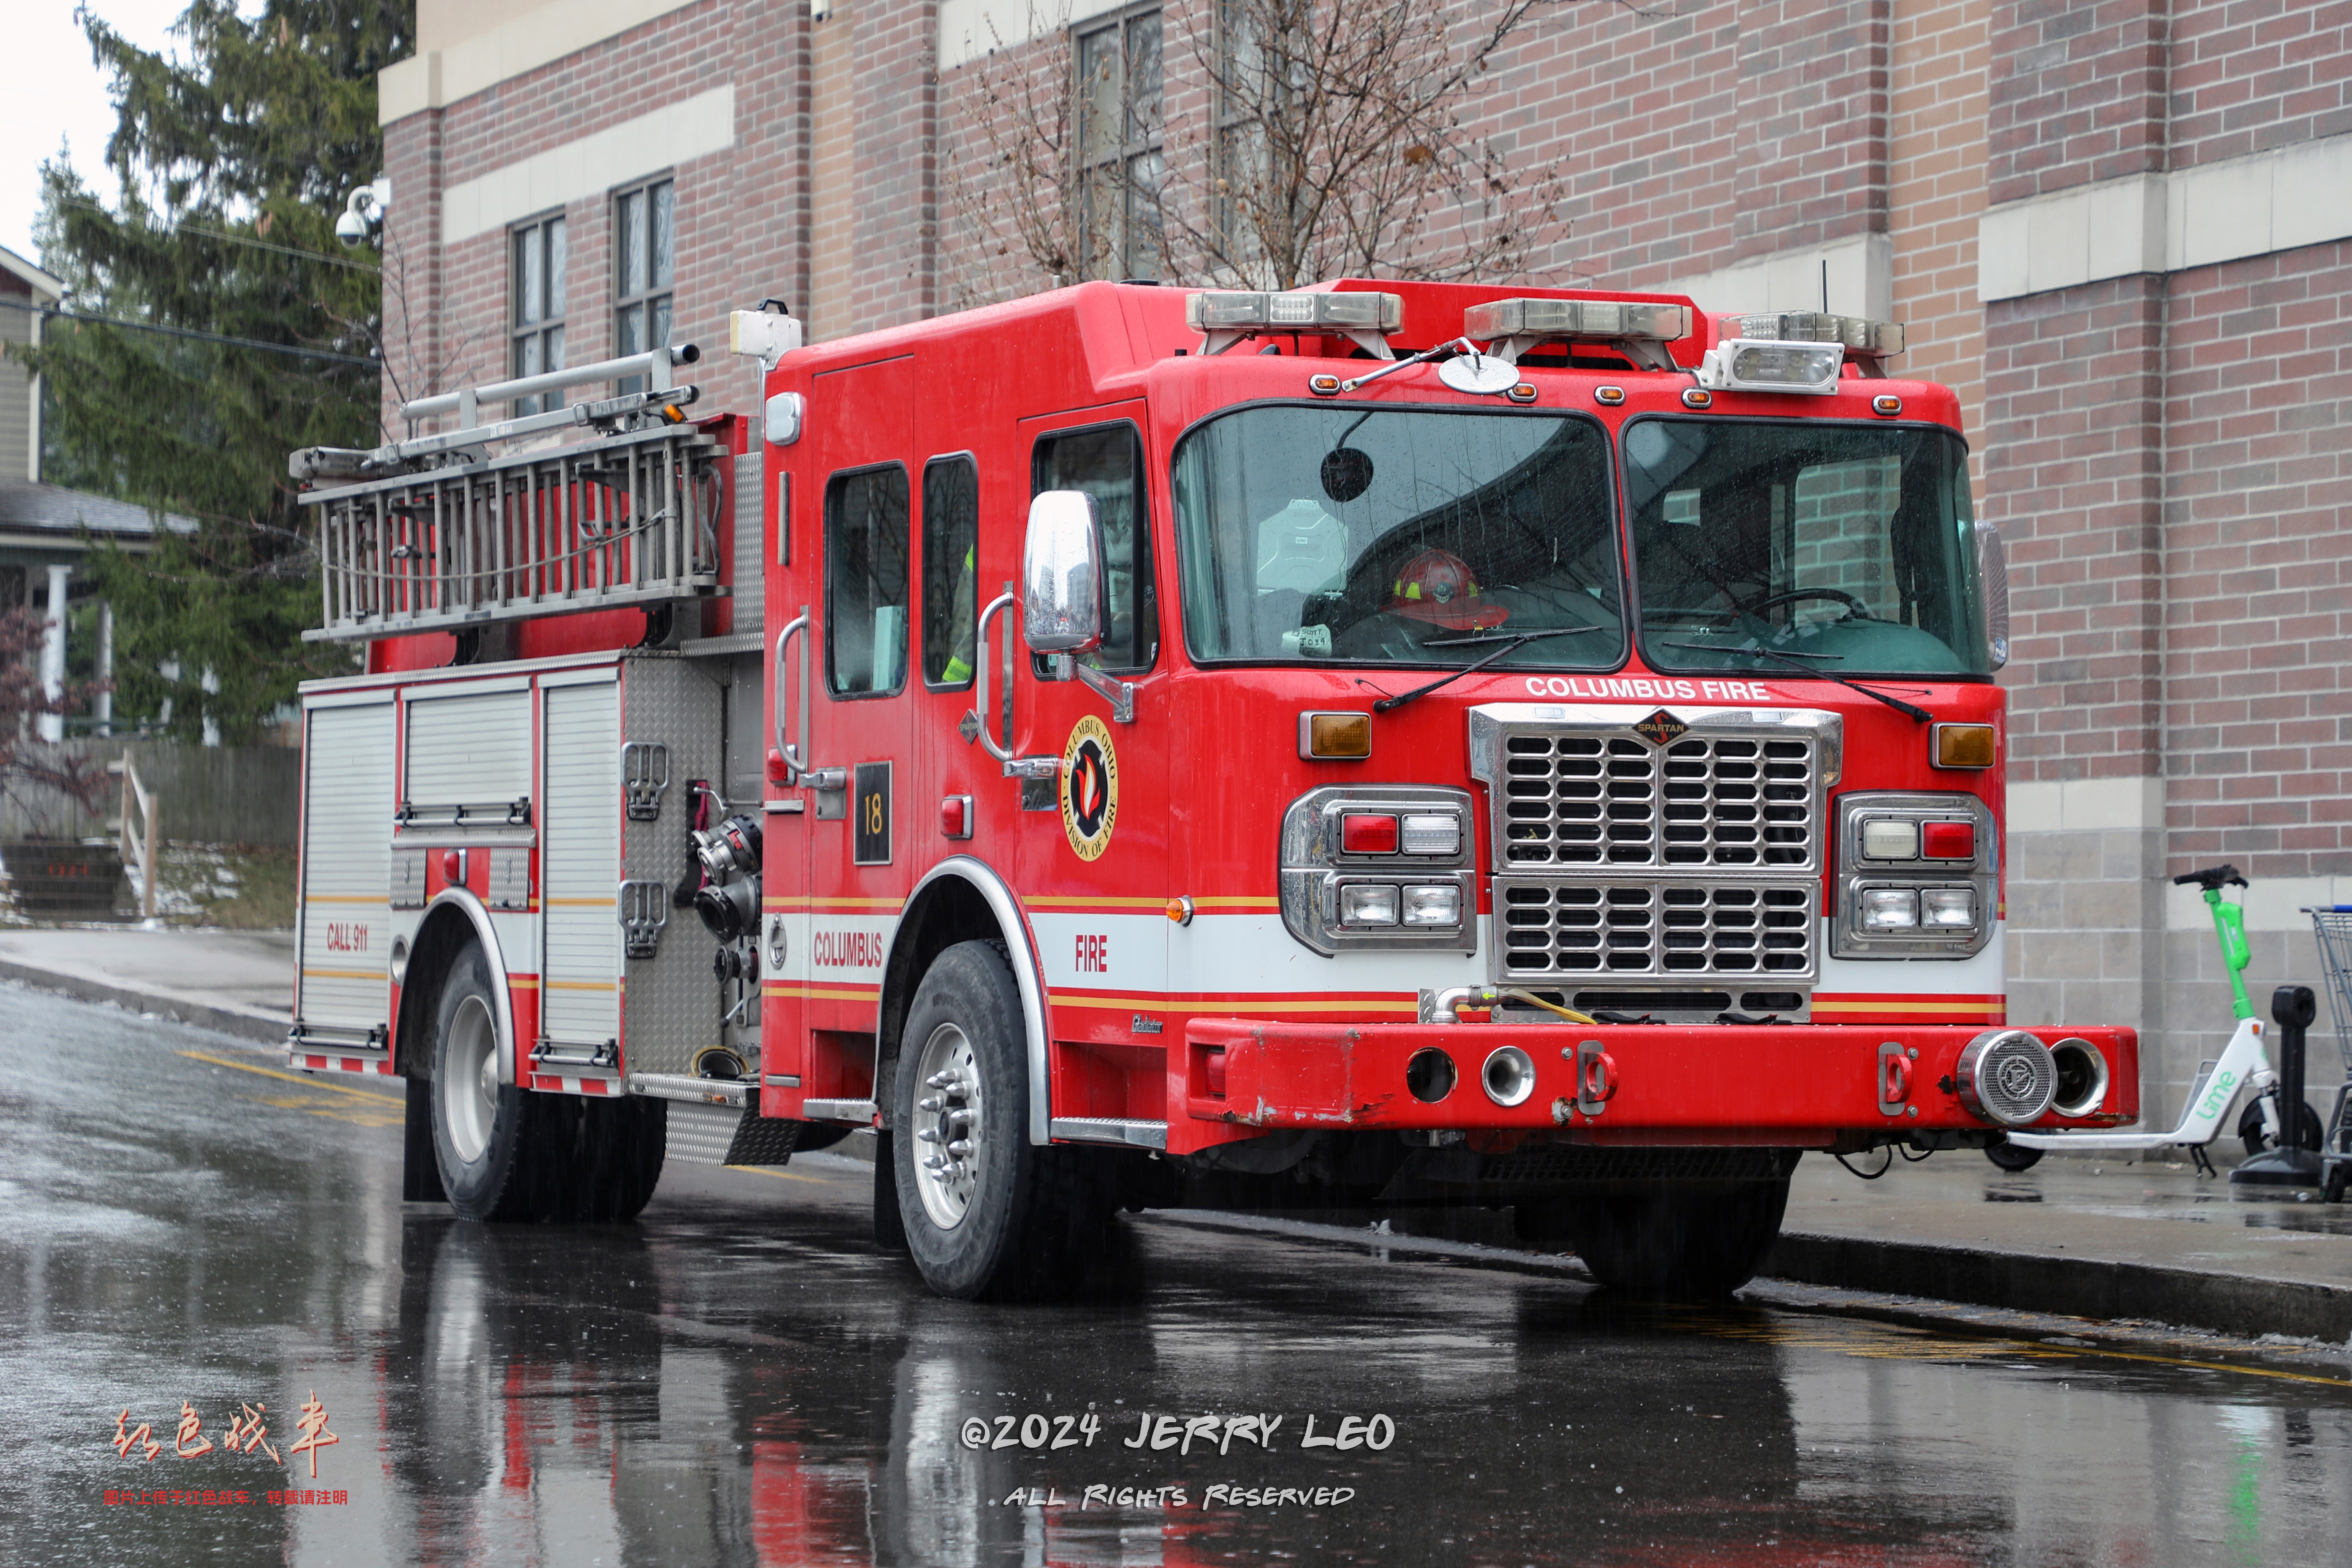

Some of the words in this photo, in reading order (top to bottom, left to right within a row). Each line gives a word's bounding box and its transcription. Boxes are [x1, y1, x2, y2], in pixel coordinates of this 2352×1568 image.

[1525, 677, 1696, 699] COLUMBUS
[1700, 681, 1771, 701] FIRE
[1638, 723, 1685, 732] SPARTAN
[1063, 720, 1100, 779] COLUMBUS
[1101, 733, 1116, 779] OHIO
[865, 793, 882, 835] 18
[1062, 796, 1089, 858] DIVISION
[1092, 841, 1103, 857] OF
[1104, 797, 1116, 841] FIRE
[327, 923, 350, 951] CALL
[353, 924, 368, 952] 911
[814, 931, 882, 967] COLUMBUS
[1075, 934, 1107, 973] FIRE
[1132, 1014, 1163, 1034] Gladiator
